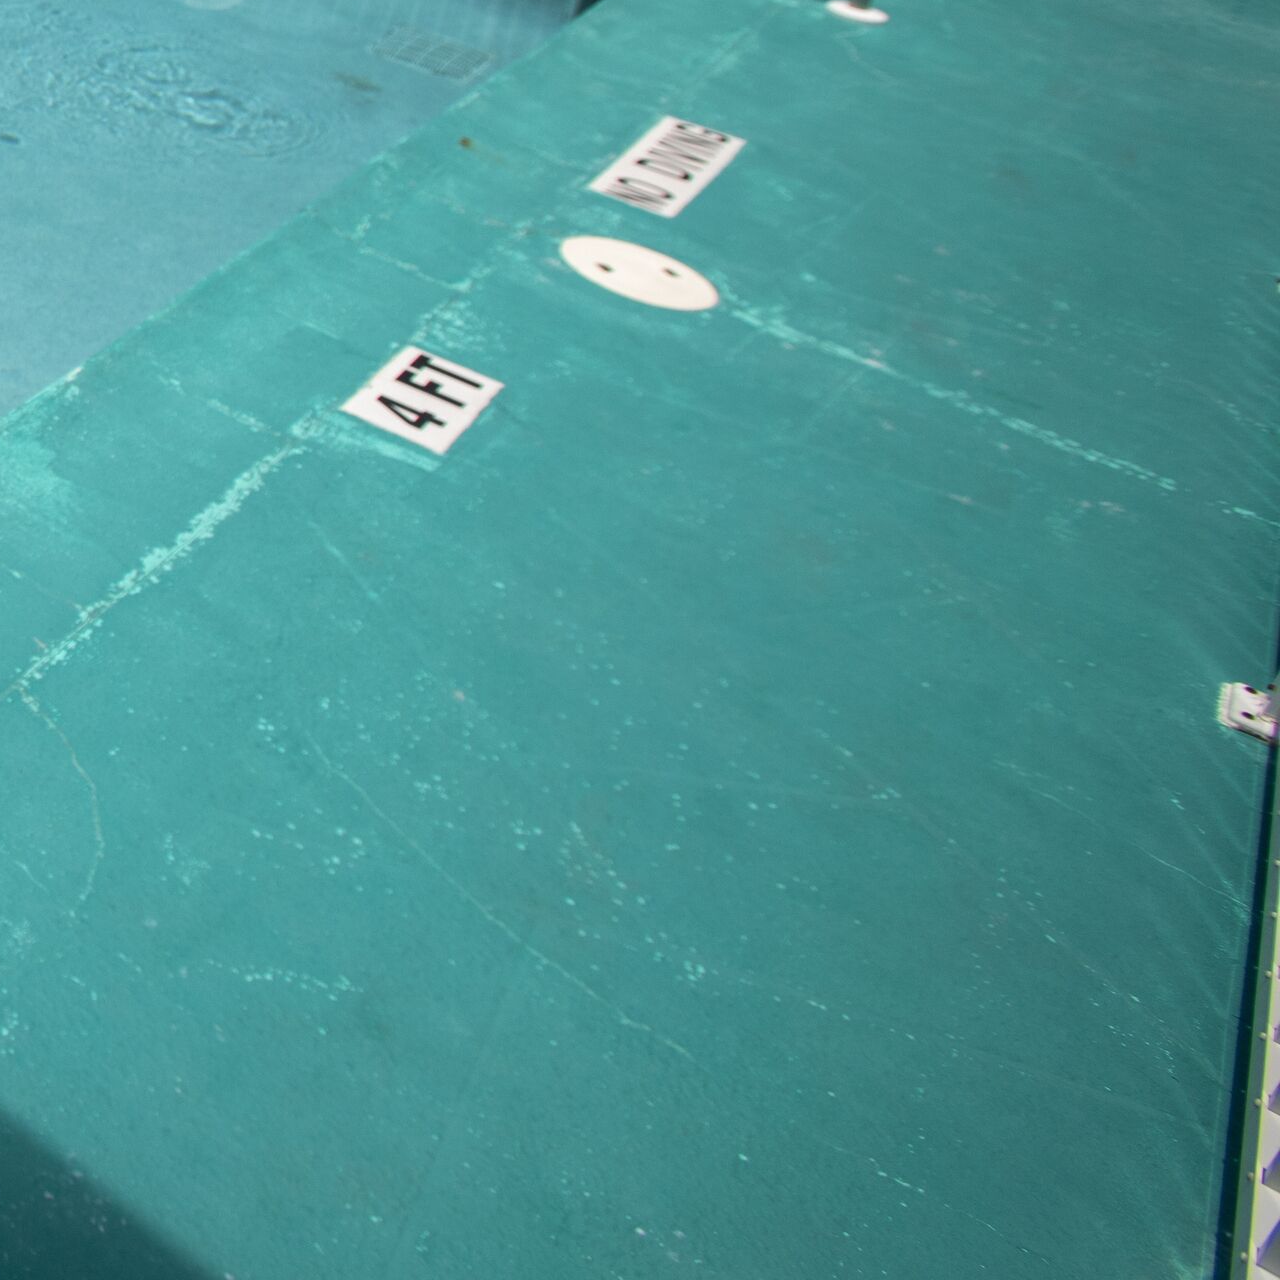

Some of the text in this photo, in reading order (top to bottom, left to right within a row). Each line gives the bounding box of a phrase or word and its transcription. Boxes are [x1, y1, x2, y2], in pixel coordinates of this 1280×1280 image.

[605, 122, 729, 212] NO DIVING
[377, 354, 483, 430] 4 FT
